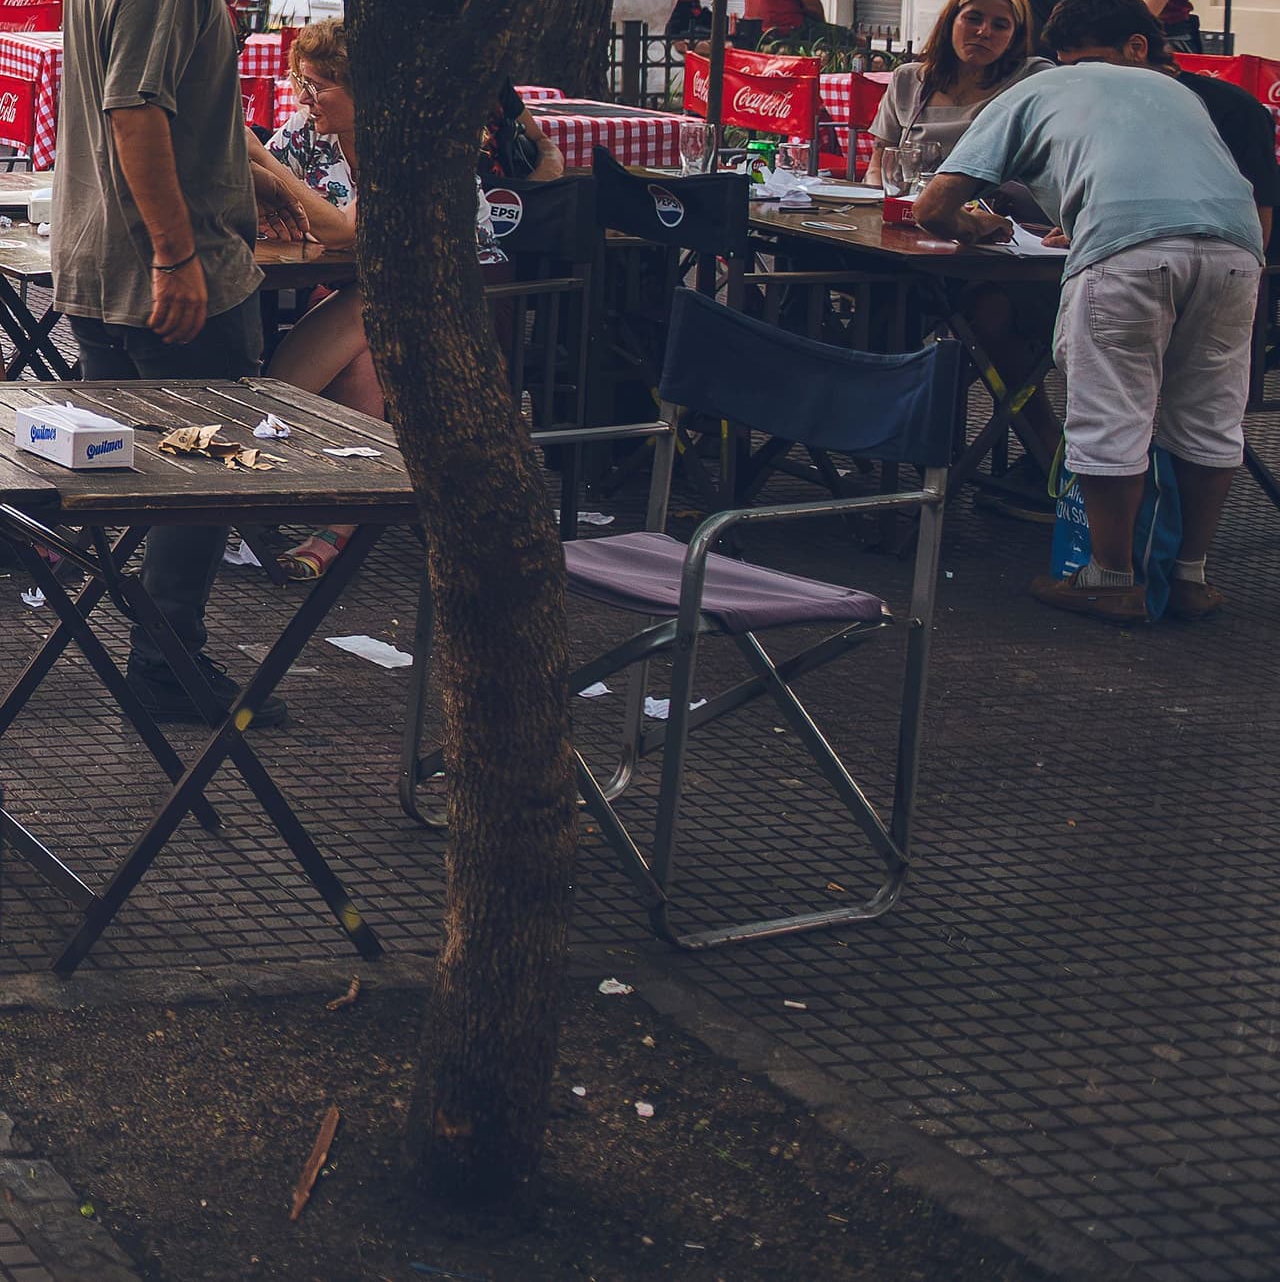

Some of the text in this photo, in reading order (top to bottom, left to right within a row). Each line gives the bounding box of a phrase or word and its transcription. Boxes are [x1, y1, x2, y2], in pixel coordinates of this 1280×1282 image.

[733, 85, 793, 119] Coca-Cola
[490, 205, 519, 221] EPSI
[30, 424, 57, 443] Quilmes
[86, 438, 124, 460] Quilmes
